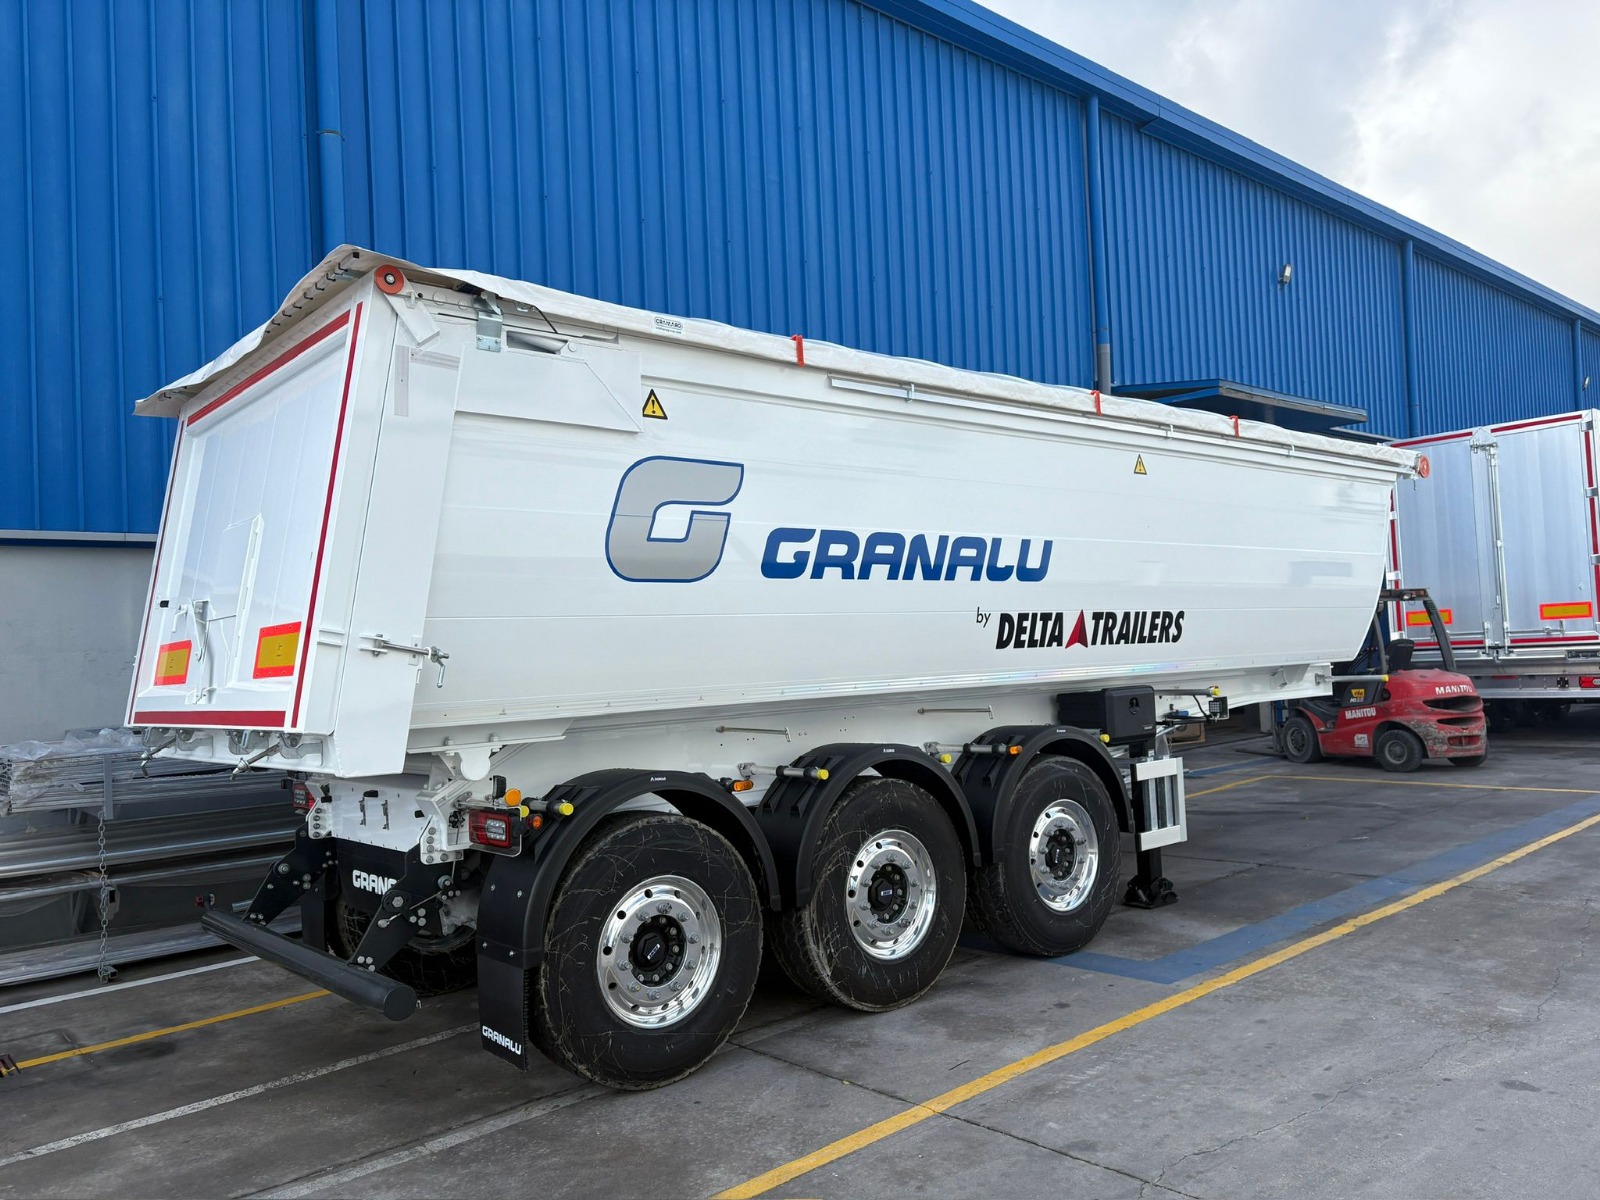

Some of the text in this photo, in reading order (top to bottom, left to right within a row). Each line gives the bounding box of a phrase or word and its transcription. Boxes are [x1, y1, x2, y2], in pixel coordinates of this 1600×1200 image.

[761, 527, 1053, 582] GRANALU
[976, 606, 1185, 650] by DELTA TRAILERS
[1344, 706, 1377, 720] MANITOU
[482, 1025, 522, 1056] GRANALU
